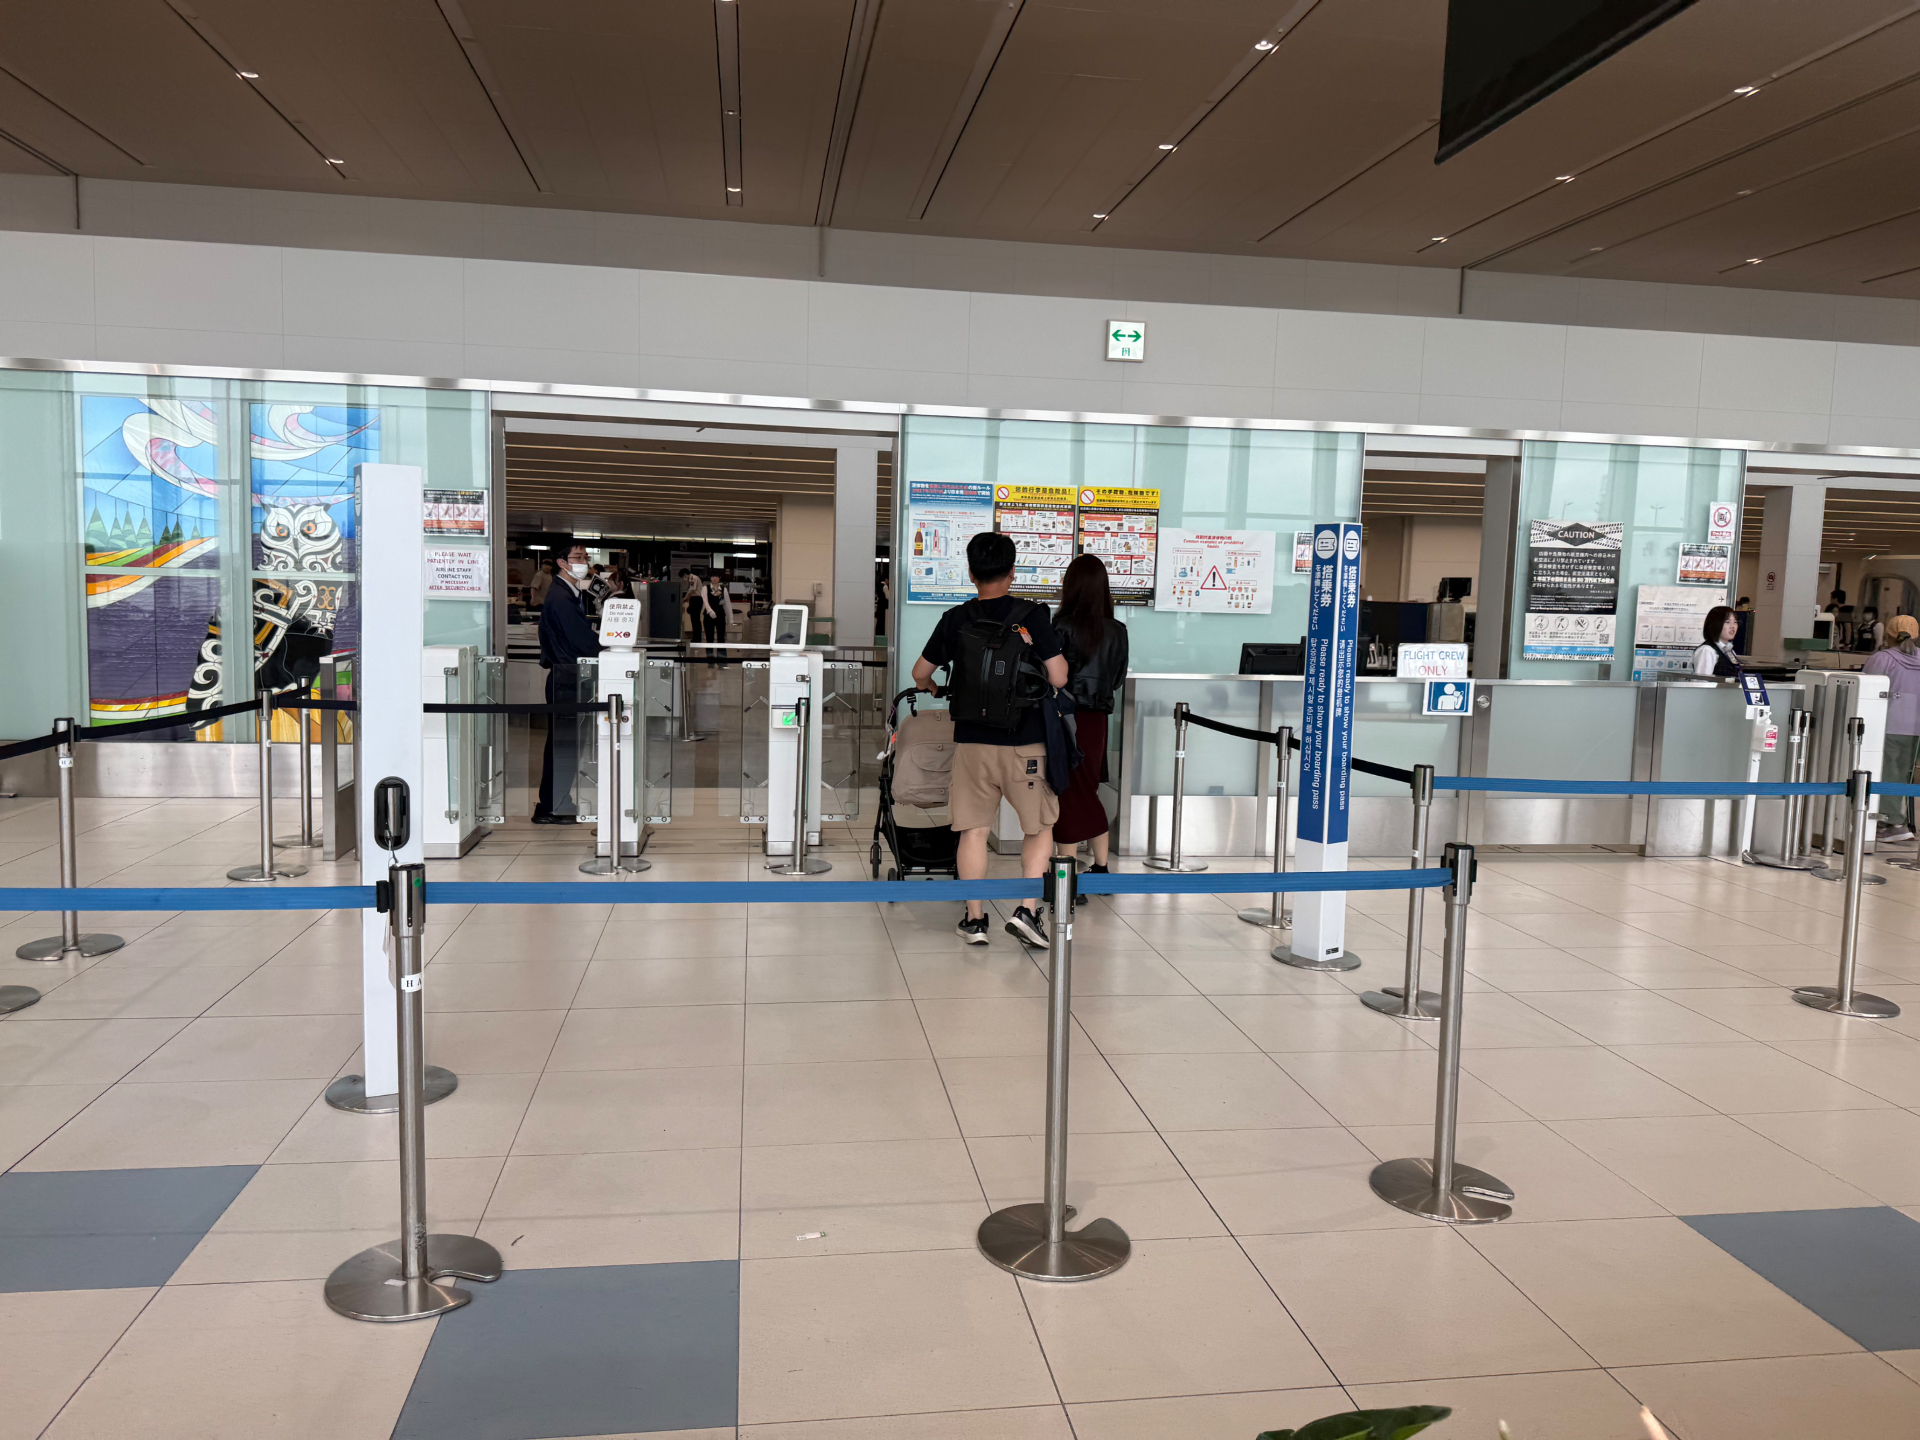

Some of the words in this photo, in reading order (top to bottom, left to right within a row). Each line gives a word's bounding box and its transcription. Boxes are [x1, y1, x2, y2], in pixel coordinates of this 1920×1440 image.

[1558, 531, 1595, 539] CAUTION
[1312, 564, 1321, 630] を準備してください
[1320, 565, 1334, 607] 搭乗券
[1347, 566, 1357, 608] 搭乗券
[1320, 639, 1328, 667] Please
[1403, 650, 1435, 660] FLIGHT
[1439, 651, 1465, 660] CREW
[1317, 669, 1326, 693] ready
[1418, 665, 1448, 676] ONLY
[1318, 695, 1325, 703] to
[1344, 696, 1350, 704] to
[1316, 705, 1325, 728] show
[1303, 735, 1312, 771] 하십시오
[1312, 751, 1323, 788] boarding
[1340, 752, 1348, 788] boarding
